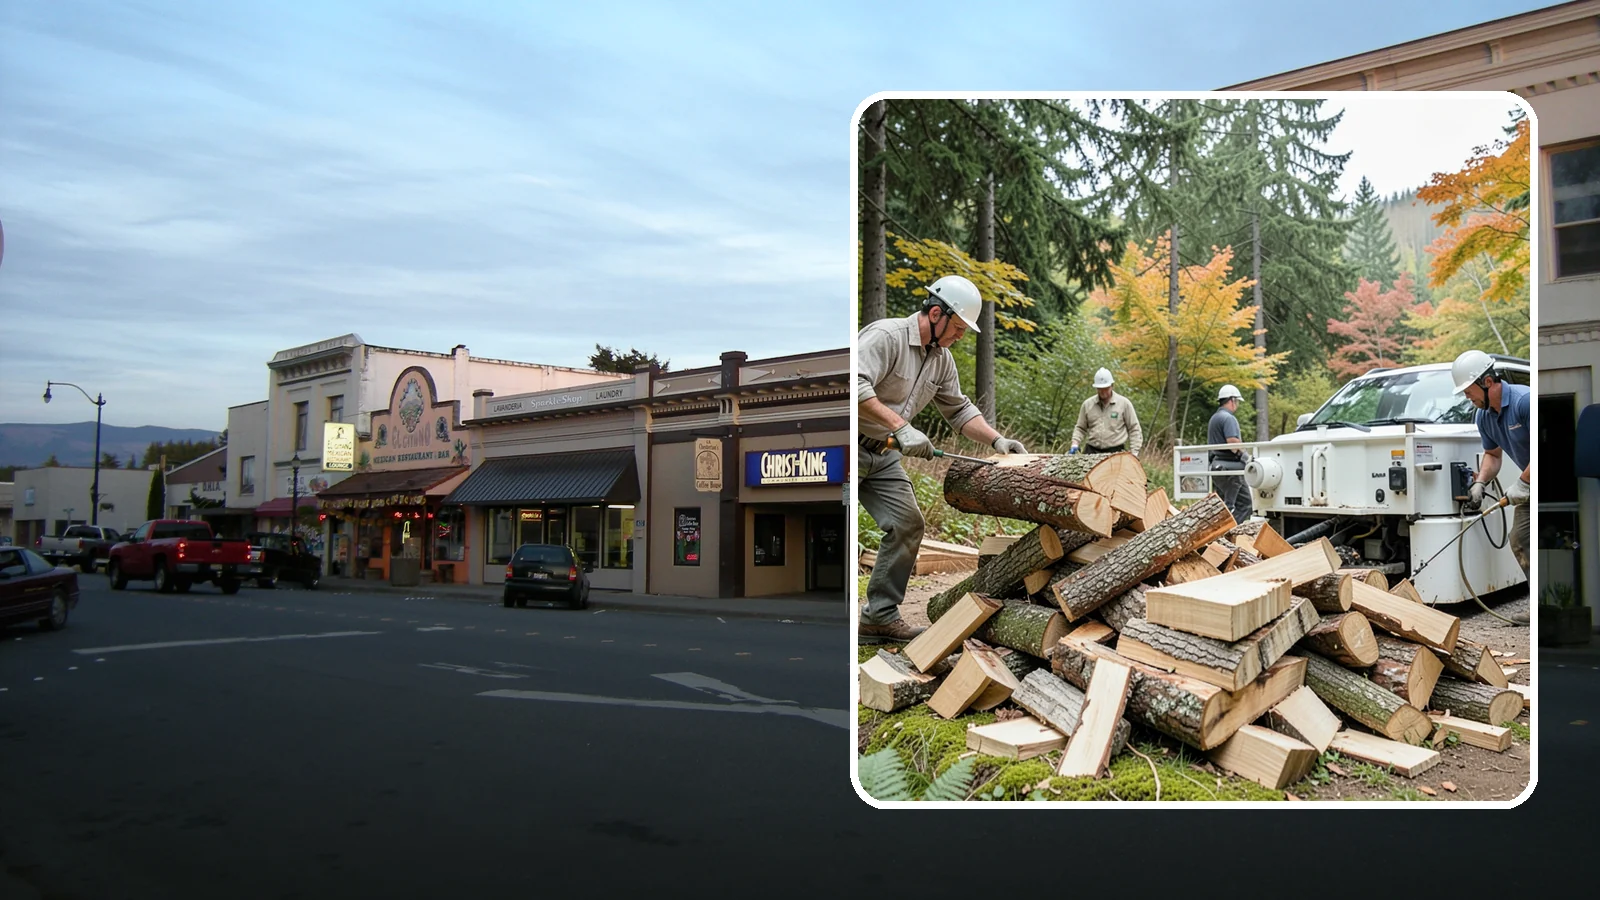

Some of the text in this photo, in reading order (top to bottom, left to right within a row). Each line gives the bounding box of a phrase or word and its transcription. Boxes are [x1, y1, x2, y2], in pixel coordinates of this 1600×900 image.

[530, 394, 582, 409] Sparkle Shop
[595, 389, 623, 400] LAUNDRY
[493, 402, 523, 412] LAVANDERIA
[373, 455, 396, 464] MEXICAN
[397, 451, 433, 462] RESTAURANT
[438, 450, 450, 459] BAR
[760, 450, 827, 478] CHRIST KING
